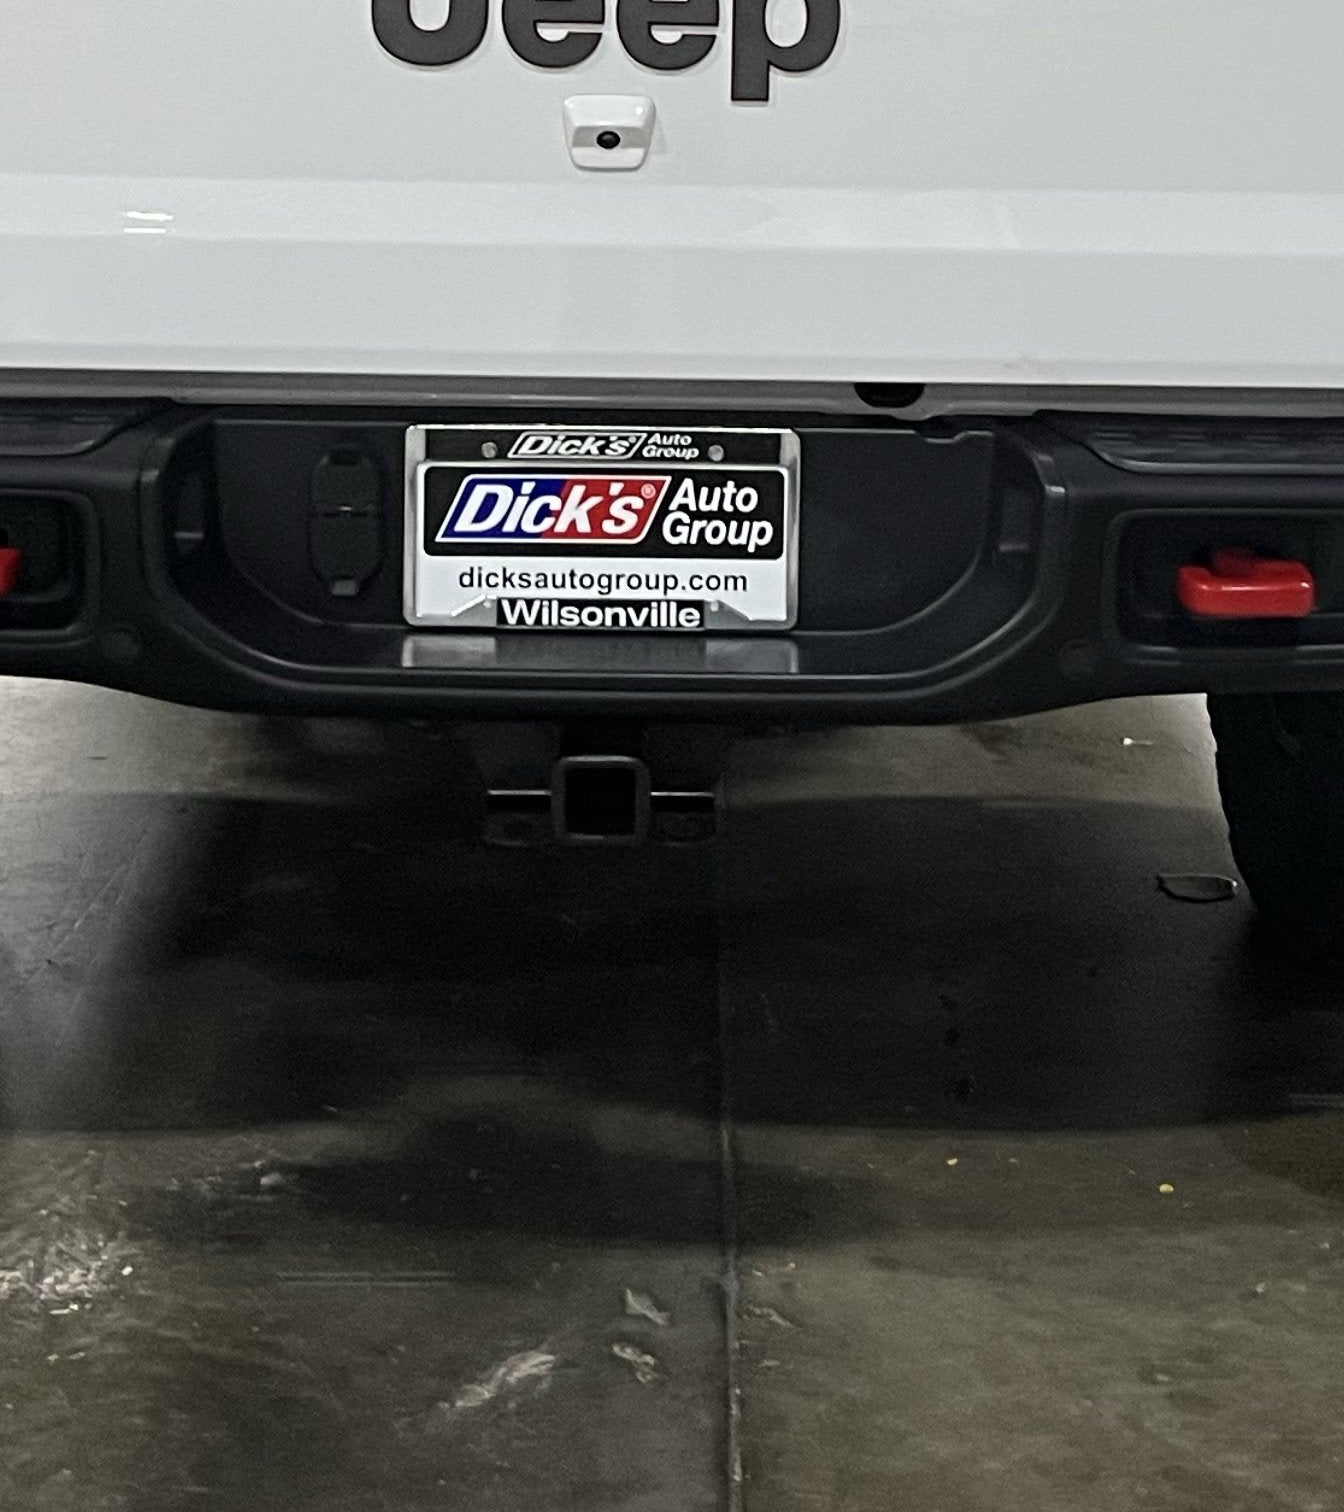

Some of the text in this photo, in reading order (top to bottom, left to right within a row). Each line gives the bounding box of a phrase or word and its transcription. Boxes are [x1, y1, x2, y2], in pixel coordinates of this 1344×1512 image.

[518, 433, 692, 456] Dick's Auto
[642, 445, 699, 460] Group
[454, 478, 759, 535] Dick's Auto
[662, 513, 774, 552] Group
[459, 566, 747, 596] dicksautogroup.com
[501, 599, 701, 628] Wilsonville
